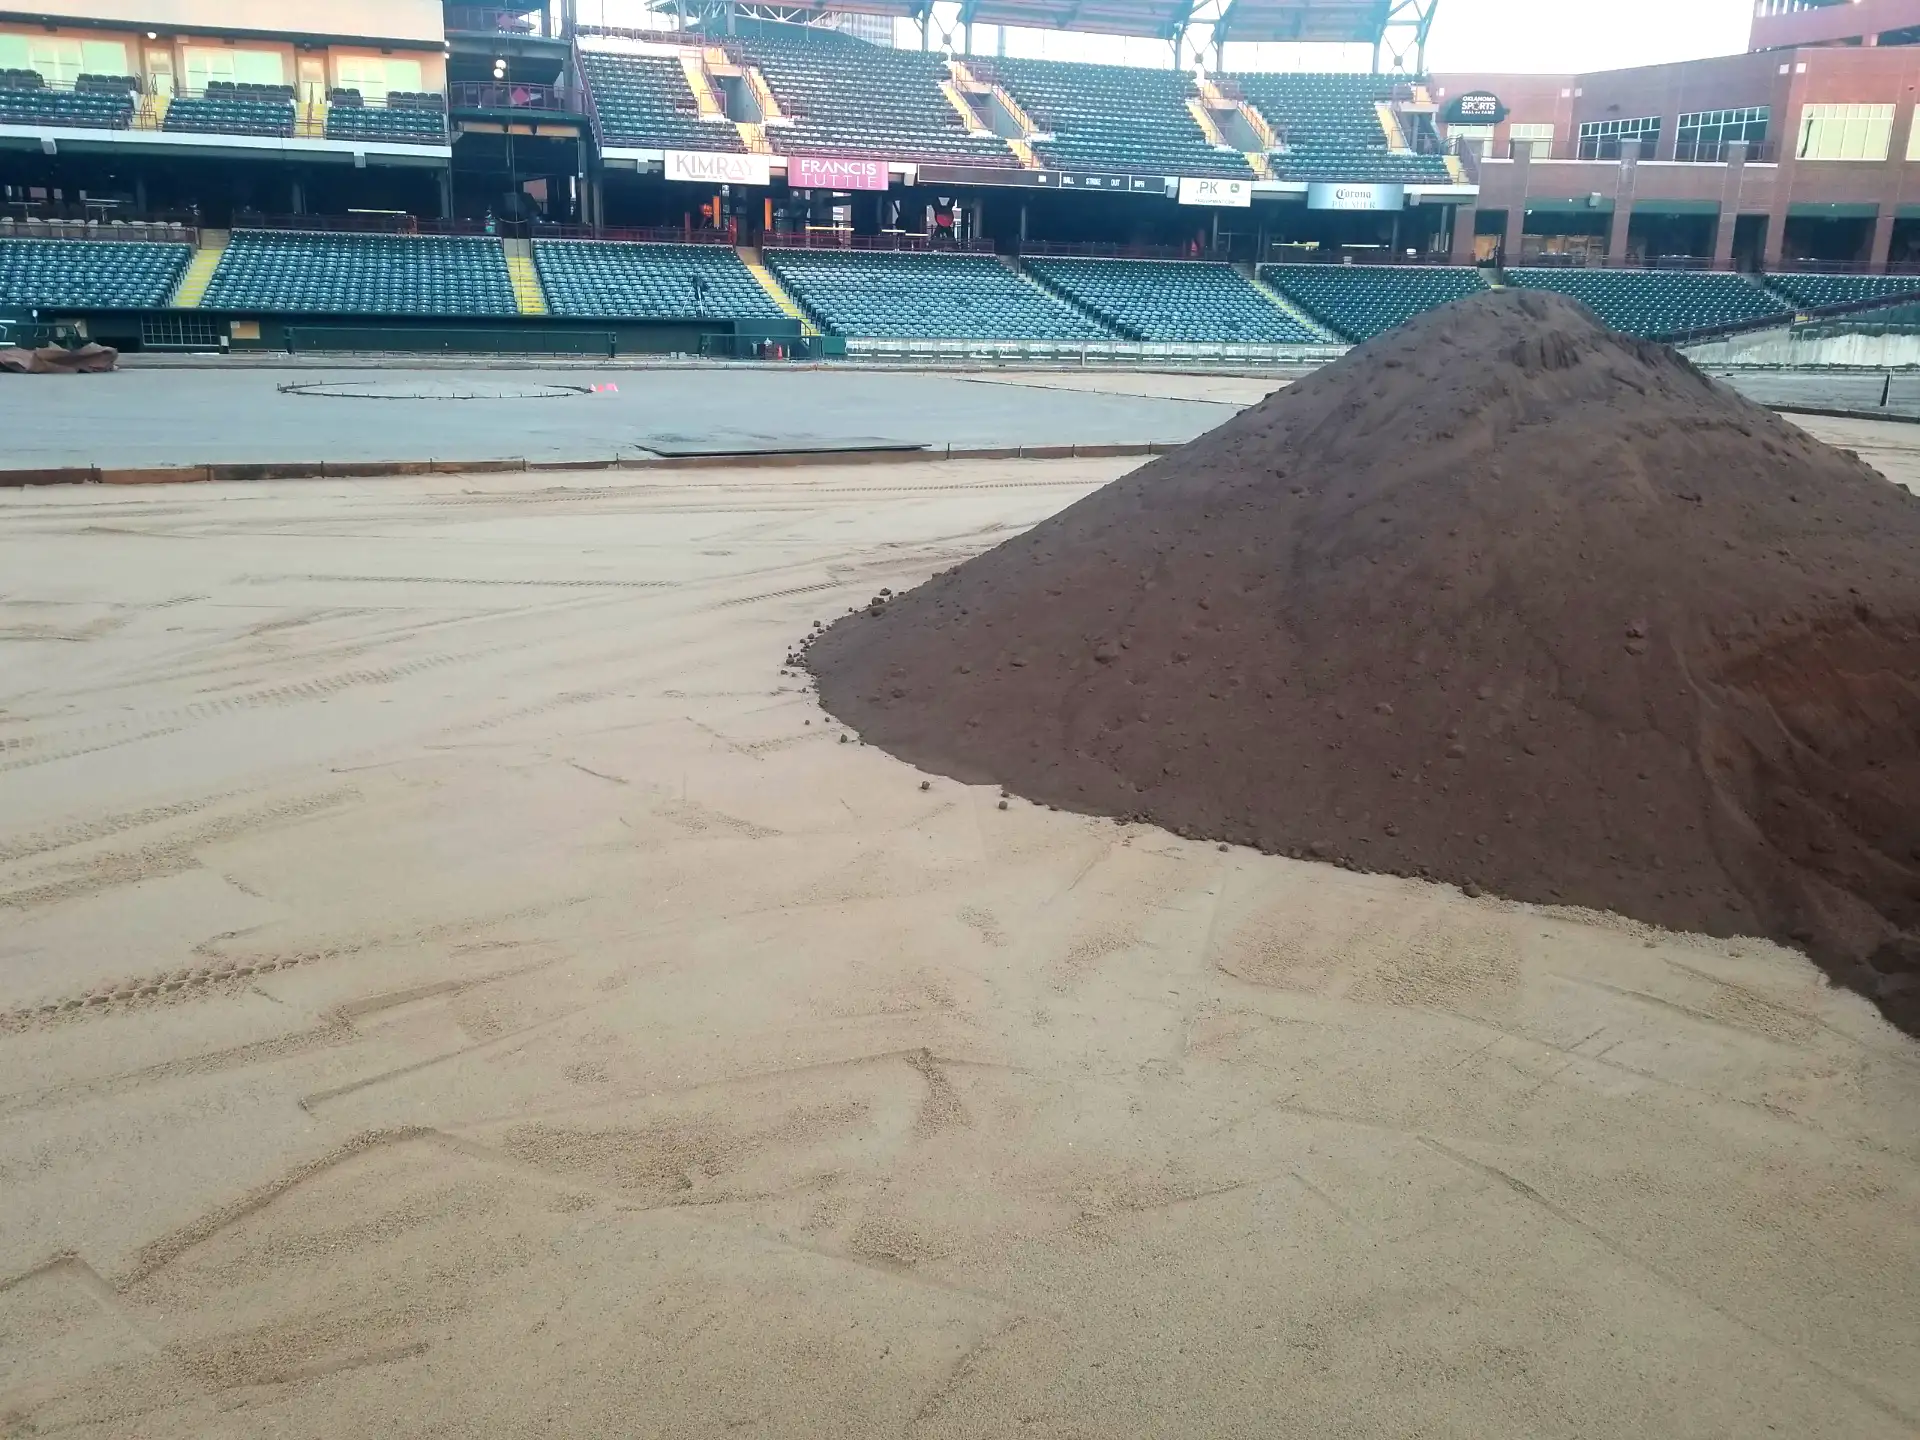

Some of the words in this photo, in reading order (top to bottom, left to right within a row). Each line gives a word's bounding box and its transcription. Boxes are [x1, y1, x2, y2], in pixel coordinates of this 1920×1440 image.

[1461, 101, 1496, 110] SPORTS
[676, 154, 753, 180] KIMRAY
[801, 159, 877, 176] FRANCIS
[802, 173, 877, 188] TUTTLE
[1110, 178, 1121, 187] OUT
[1199, 181, 1219, 194] PK
[1335, 188, 1372, 200] Corona
